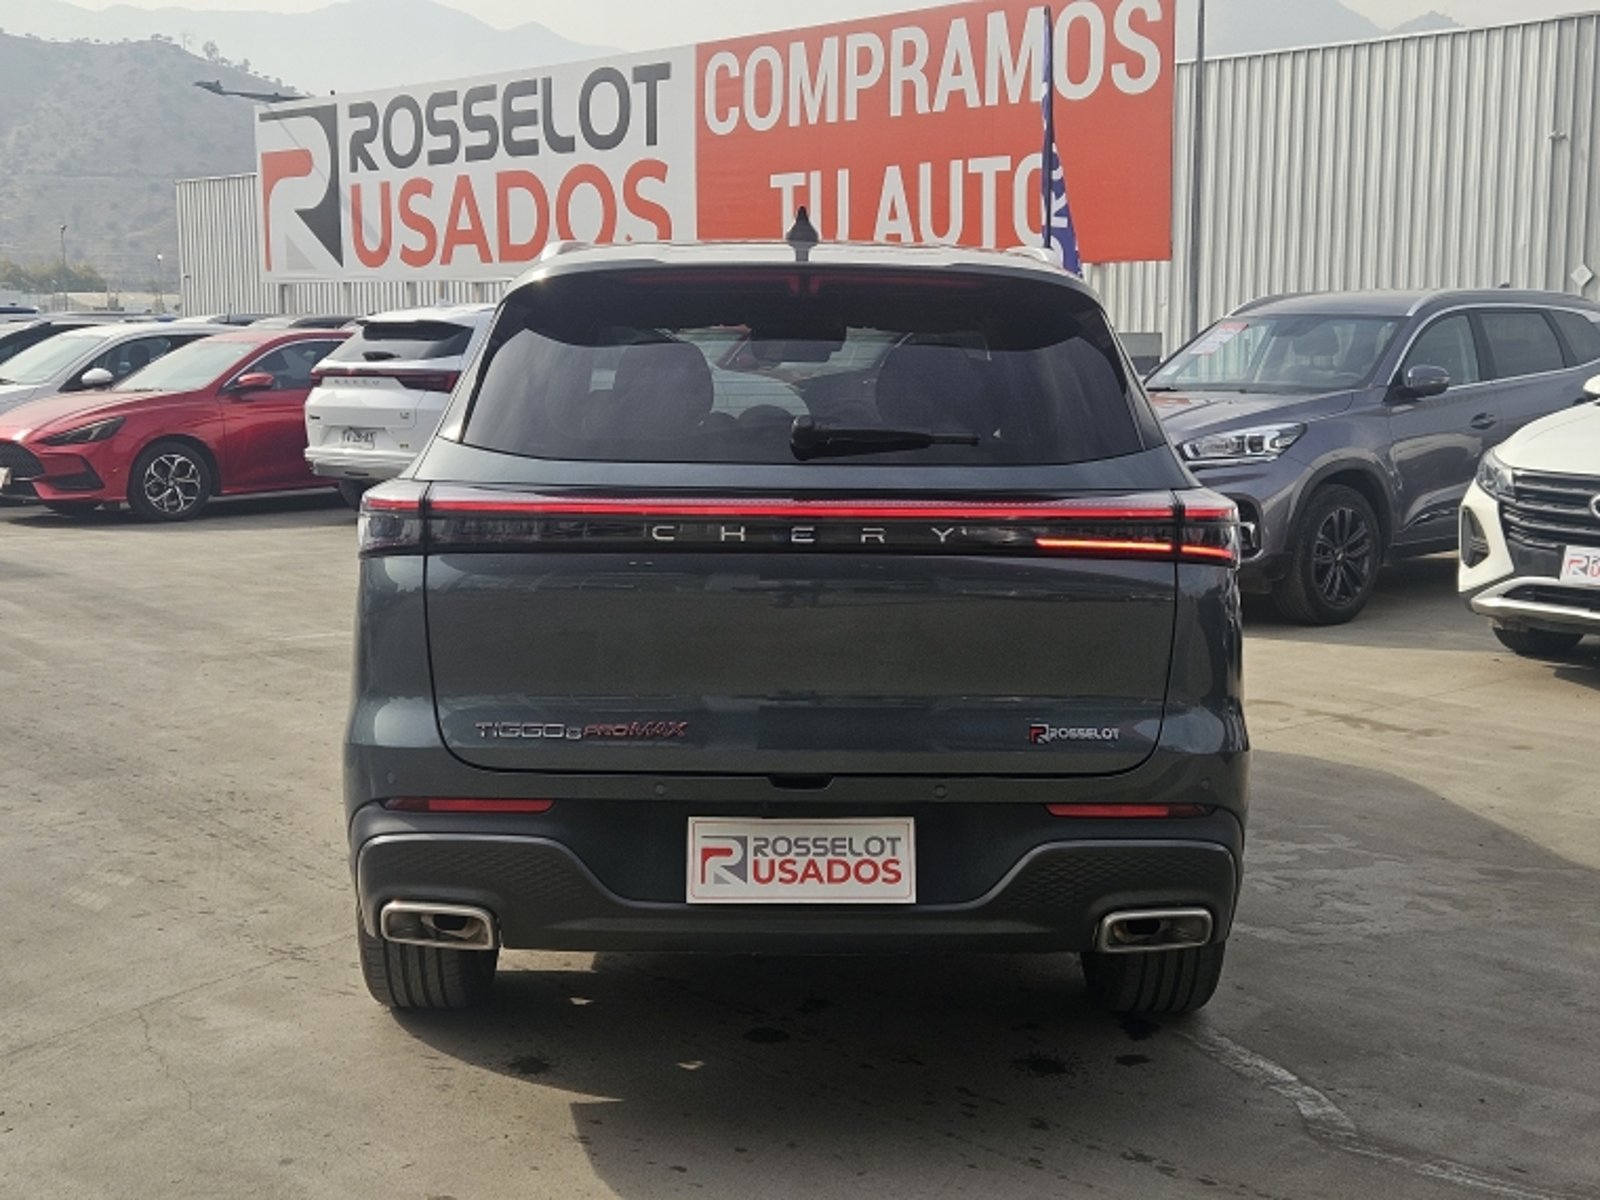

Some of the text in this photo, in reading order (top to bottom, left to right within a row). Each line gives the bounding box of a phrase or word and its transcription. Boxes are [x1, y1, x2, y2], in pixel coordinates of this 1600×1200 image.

[704, 0, 1162, 136] COMPRAMOS
[349, 62, 671, 173] ROSSELOT
[350, 158, 672, 268] USADOS
[770, 168, 850, 242] TU
[652, 525, 955, 543] CHERY
[1050, 727, 1119, 740] ROSSELOT
[753, 836, 902, 857] ROSSELOT
[753, 858, 902, 884] USADOS
